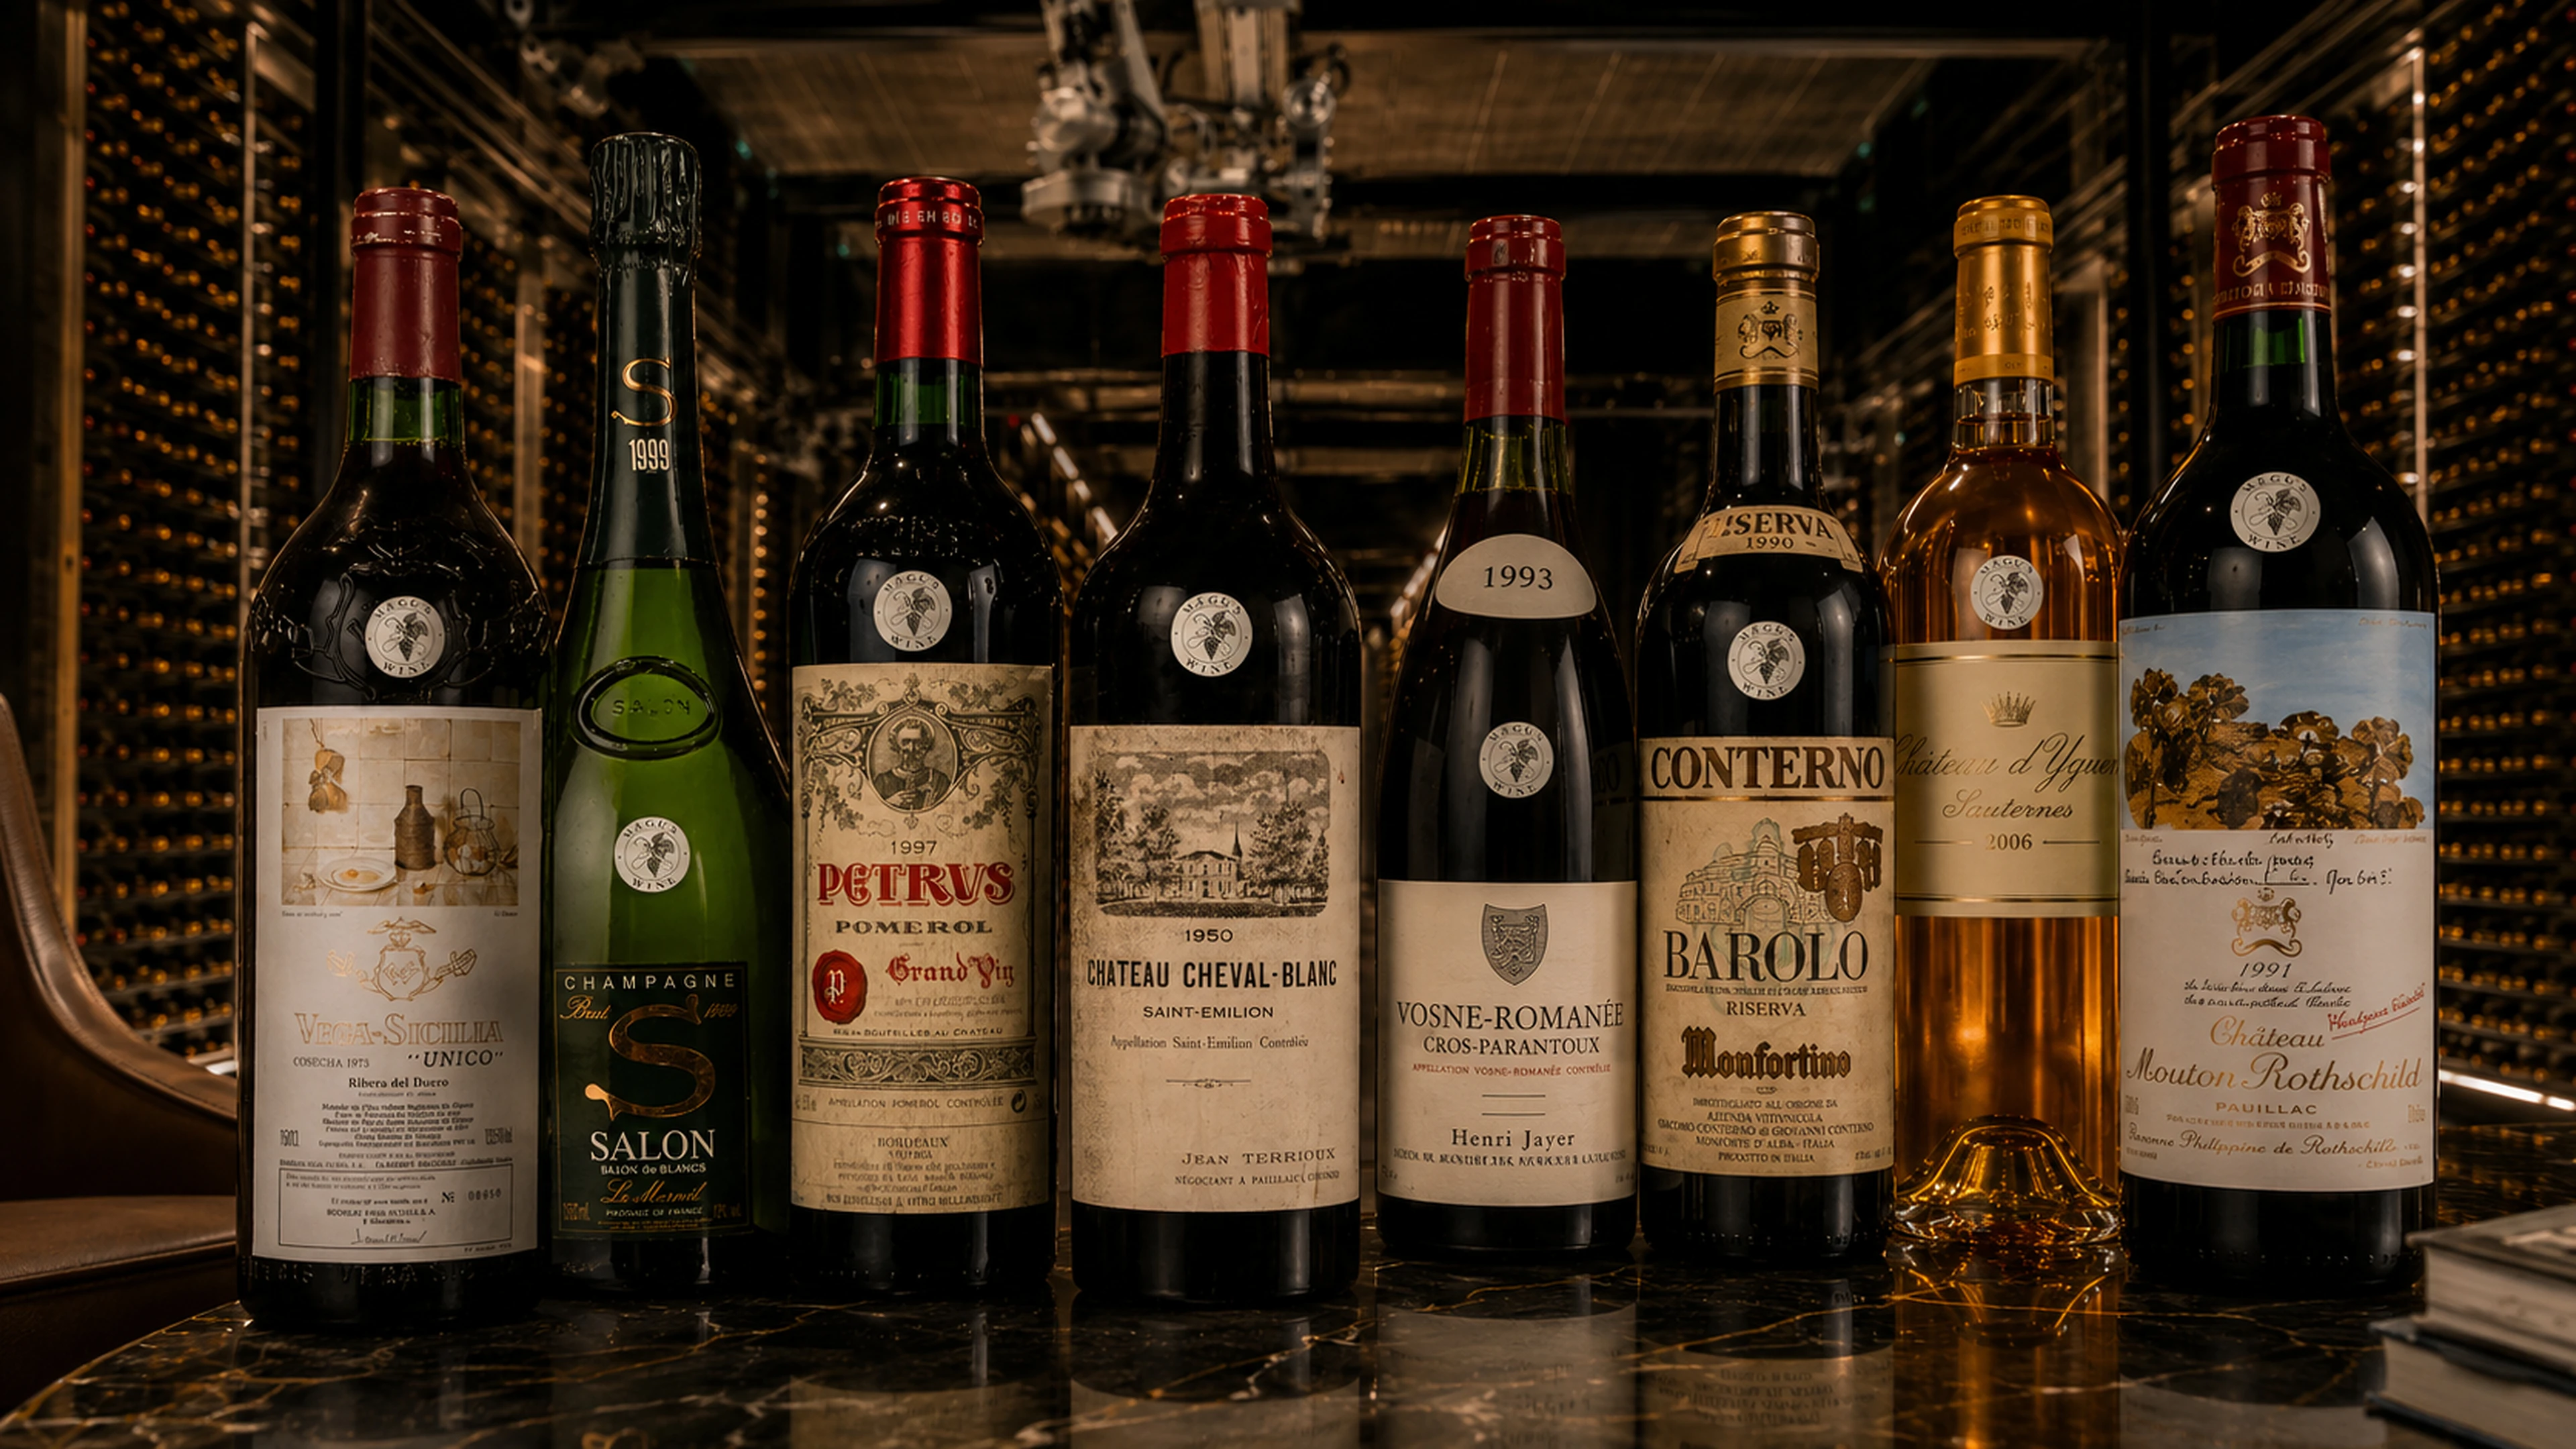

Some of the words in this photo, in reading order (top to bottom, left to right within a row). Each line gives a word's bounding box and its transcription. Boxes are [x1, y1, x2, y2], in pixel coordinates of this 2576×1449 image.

[611, 357, 678, 427] S
[629, 439, 670, 471] 1999
[1746, 537, 1794, 550] 1990
[2249, 535, 2301, 549] WINE
[1483, 565, 1554, 590] 1993
[383, 661, 430, 675] WINE
[1186, 657, 1234, 674] WINE
[1652, 745, 1886, 790] CONTERNO
[1942, 789, 2073, 818] Sauternes
[890, 840, 938, 855] 1997
[1985, 833, 2033, 851] 2006
[632, 877, 676, 890] WINE
[835, 920, 993, 934] POMEROL
[1185, 929, 1234, 943] 1950
[1663, 930, 1869, 983] BAROLO
[885, 951, 968, 986] Grand
[1087, 959, 1170, 988] CHATEAU
[1183, 959, 1338, 989] CHEVAL-BLANC
[2239, 962, 2292, 979] 1991
[564, 973, 735, 990] CHAMPAGNE
[1143, 1006, 1274, 1018] SAINT-EMILION
[1397, 999, 1624, 1031] VOSNE-ROMANÉE
[1726, 1001, 1807, 1017] RISERVA
[294, 1012, 504, 1046] VEGA-SICILIA
[2210, 1015, 2325, 1048] Château
[1110, 1034, 1167, 1051] Appellation
[1173, 1035, 1253, 1050] Saint-Emilion
[1423, 1036, 1601, 1055] CROS-PARANTOUX
[585, 993, 716, 1121] S
[1680, 1025, 1851, 1080] Monfortino
[292, 1056, 343, 1069] COSECHA
[1412, 1063, 1469, 1075] APPELLATION
[2126, 1046, 2235, 1089] Mouton
[2240, 1051, 2423, 1091] Rothschild
[349, 1077, 388, 1089] Ribera
[391, 1077, 409, 1088] del
[413, 1077, 449, 1088] Duero
[2215, 1102, 2318, 1115] PAUILLAC
[590, 1128, 716, 1162] SALON
[1451, 1128, 1512, 1147] Henri
[1521, 1129, 1576, 1152] Jayer
[2273, 1142, 2294, 1155] de
[1181, 1152, 1230, 1166] JEAN
[1242, 1147, 1337, 1165] TERRIOUX
